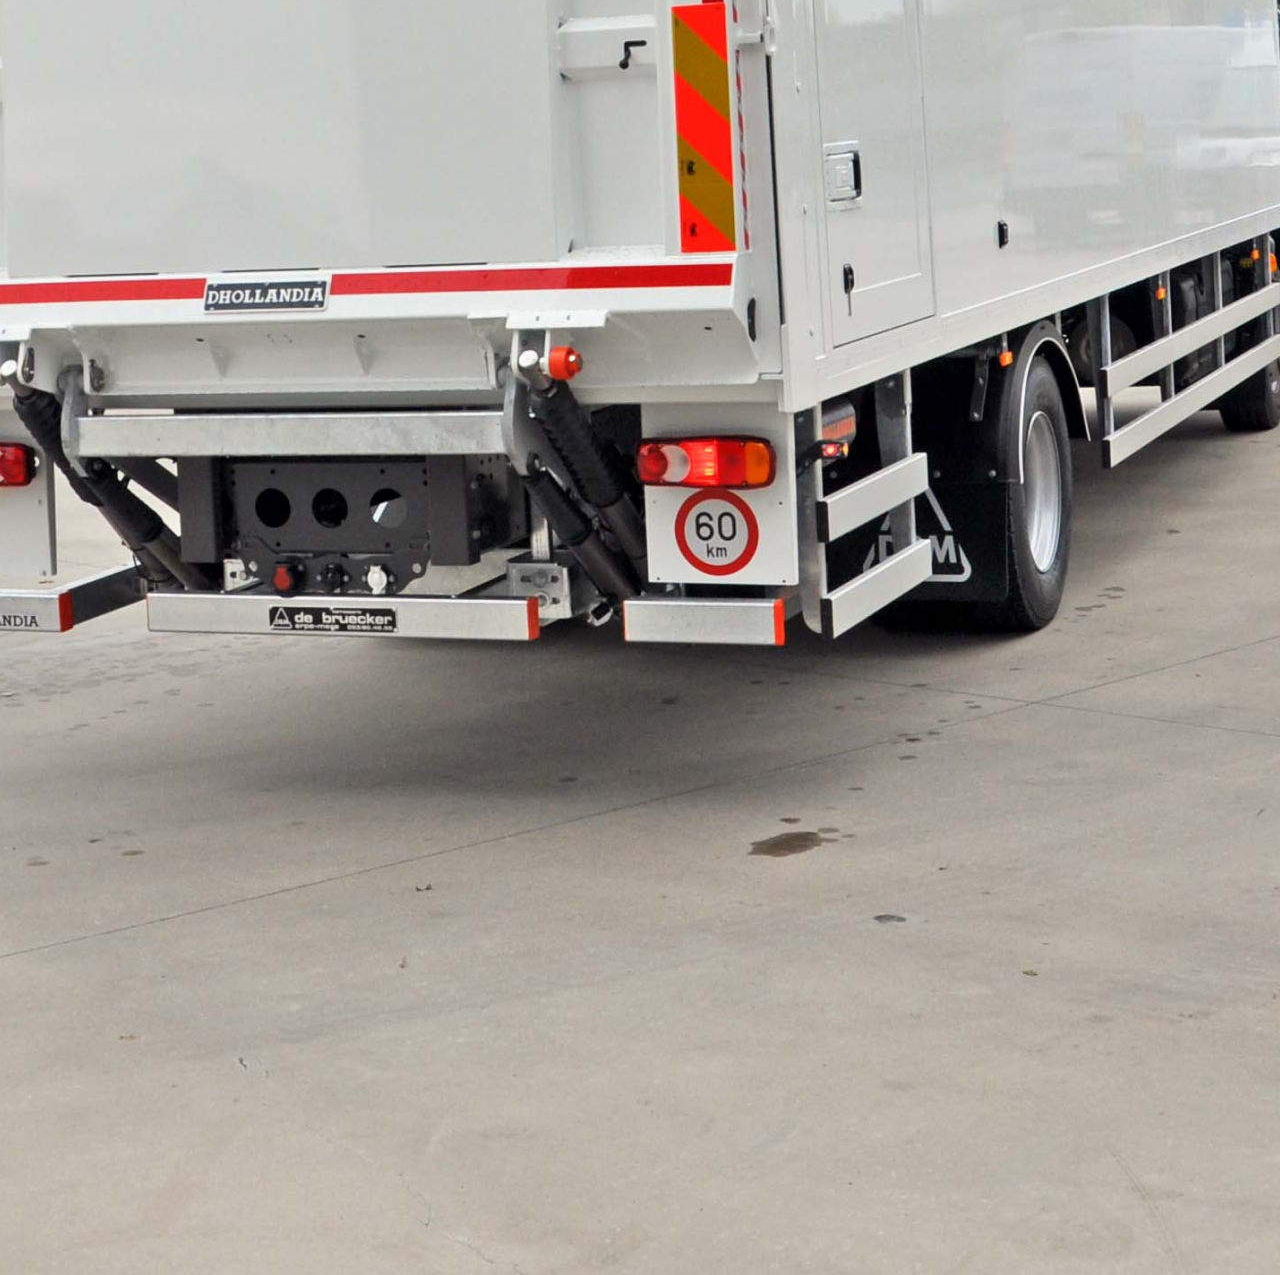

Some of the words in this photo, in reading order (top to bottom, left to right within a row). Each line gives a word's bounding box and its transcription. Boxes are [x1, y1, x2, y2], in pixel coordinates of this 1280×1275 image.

[207, 287, 324, 305] DHOLLANDIA
[695, 512, 737, 541] 60
[706, 543, 728, 558] km
[294, 611, 313, 623] de
[322, 612, 393, 625] bruecker
